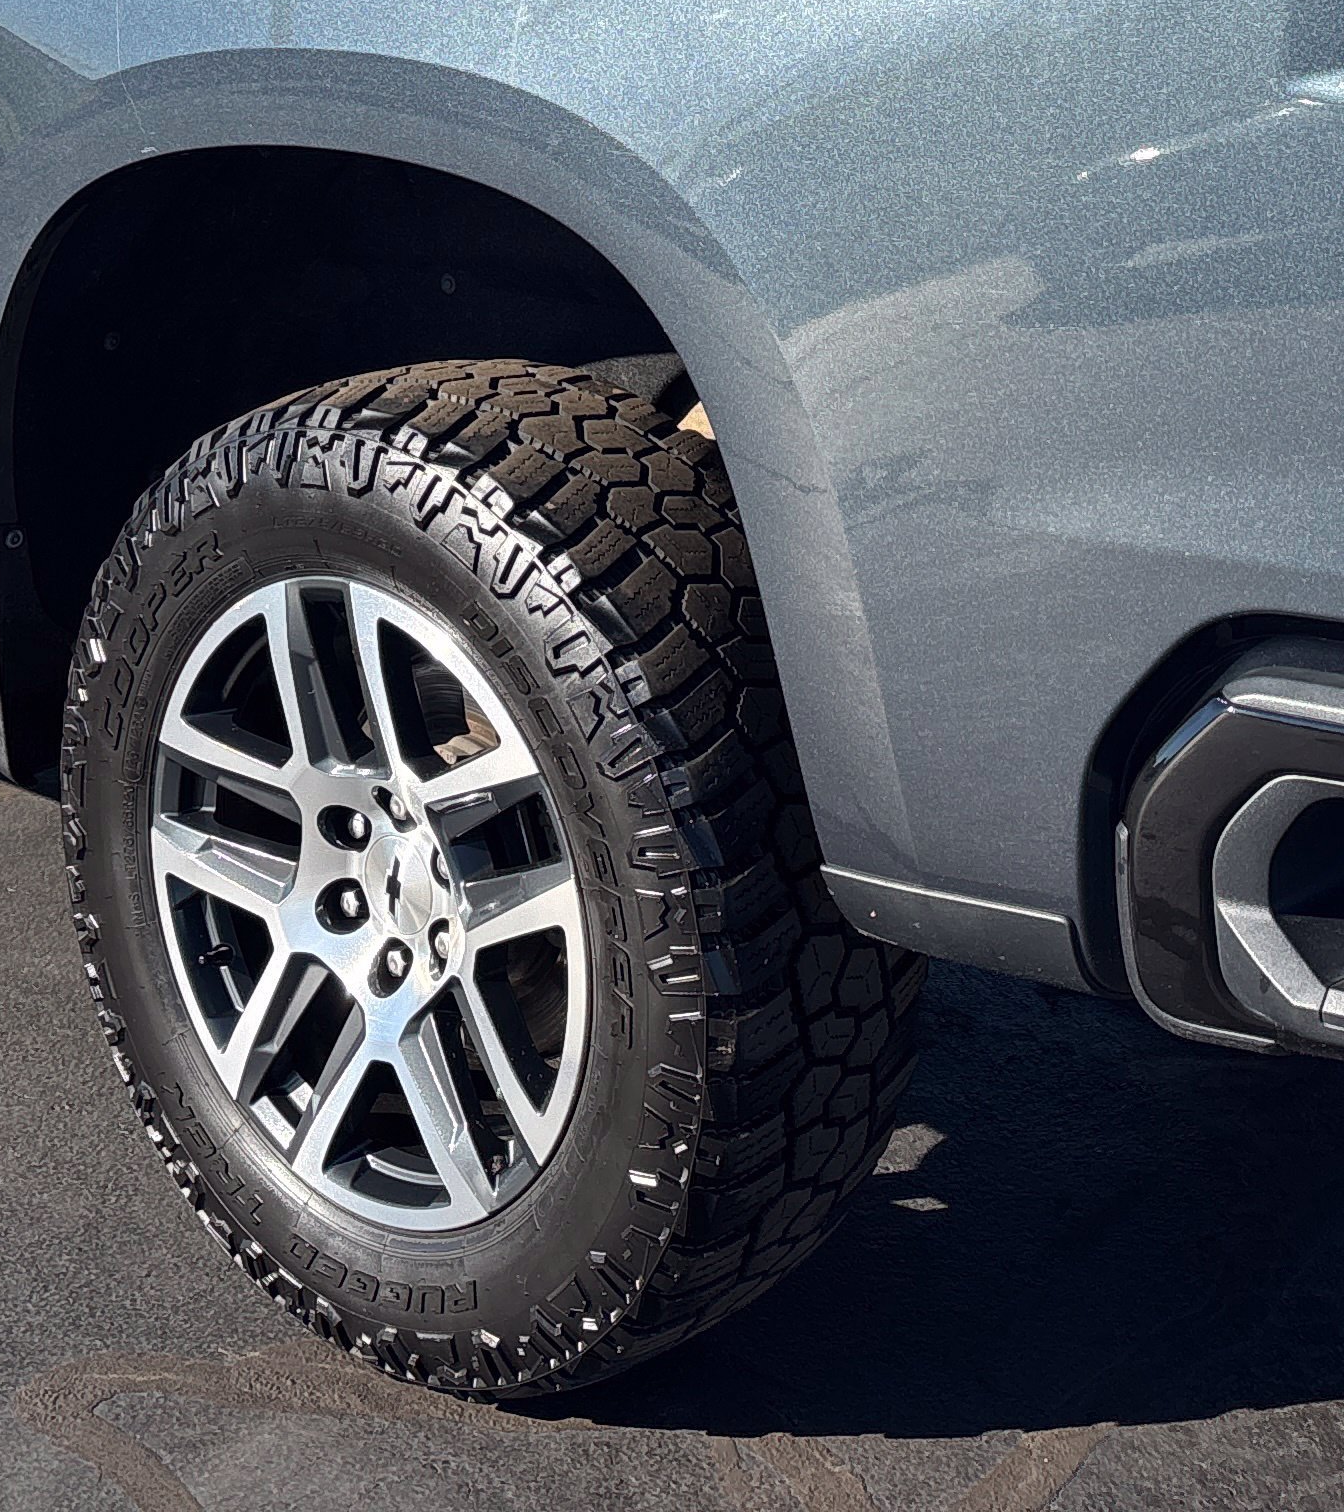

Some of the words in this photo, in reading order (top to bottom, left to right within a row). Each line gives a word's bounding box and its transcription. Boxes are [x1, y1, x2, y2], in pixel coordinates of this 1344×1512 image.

[104, 529, 224, 751] COOPER
[459, 599, 634, 1050] DISCOVERER
[161, 1082, 263, 1225] TREK
[289, 1232, 478, 1315] RUGGED
